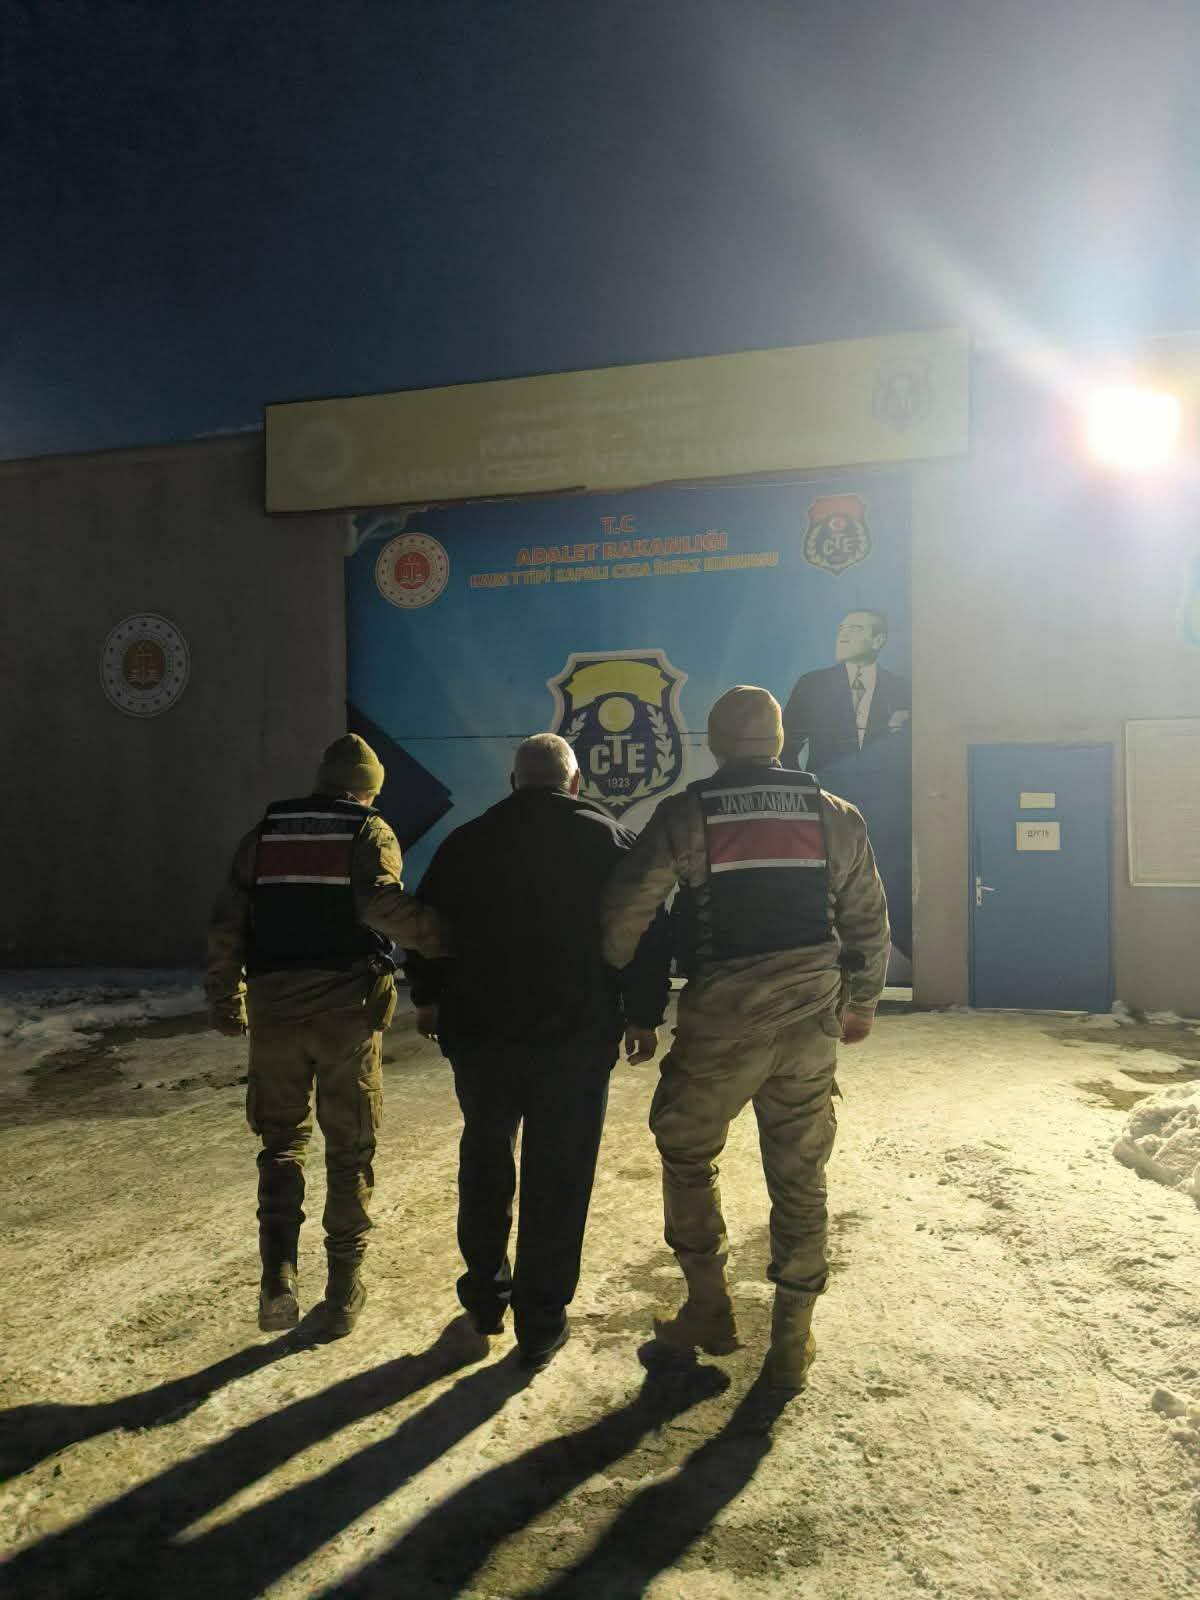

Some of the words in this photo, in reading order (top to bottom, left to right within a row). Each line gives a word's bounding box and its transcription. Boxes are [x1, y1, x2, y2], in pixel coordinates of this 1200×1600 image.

[516, 543, 598, 566] ADALET
[602, 529, 728, 560] BAKANLIĞI
[589, 735, 645, 775] CTE
[607, 777, 631, 789] 1923
